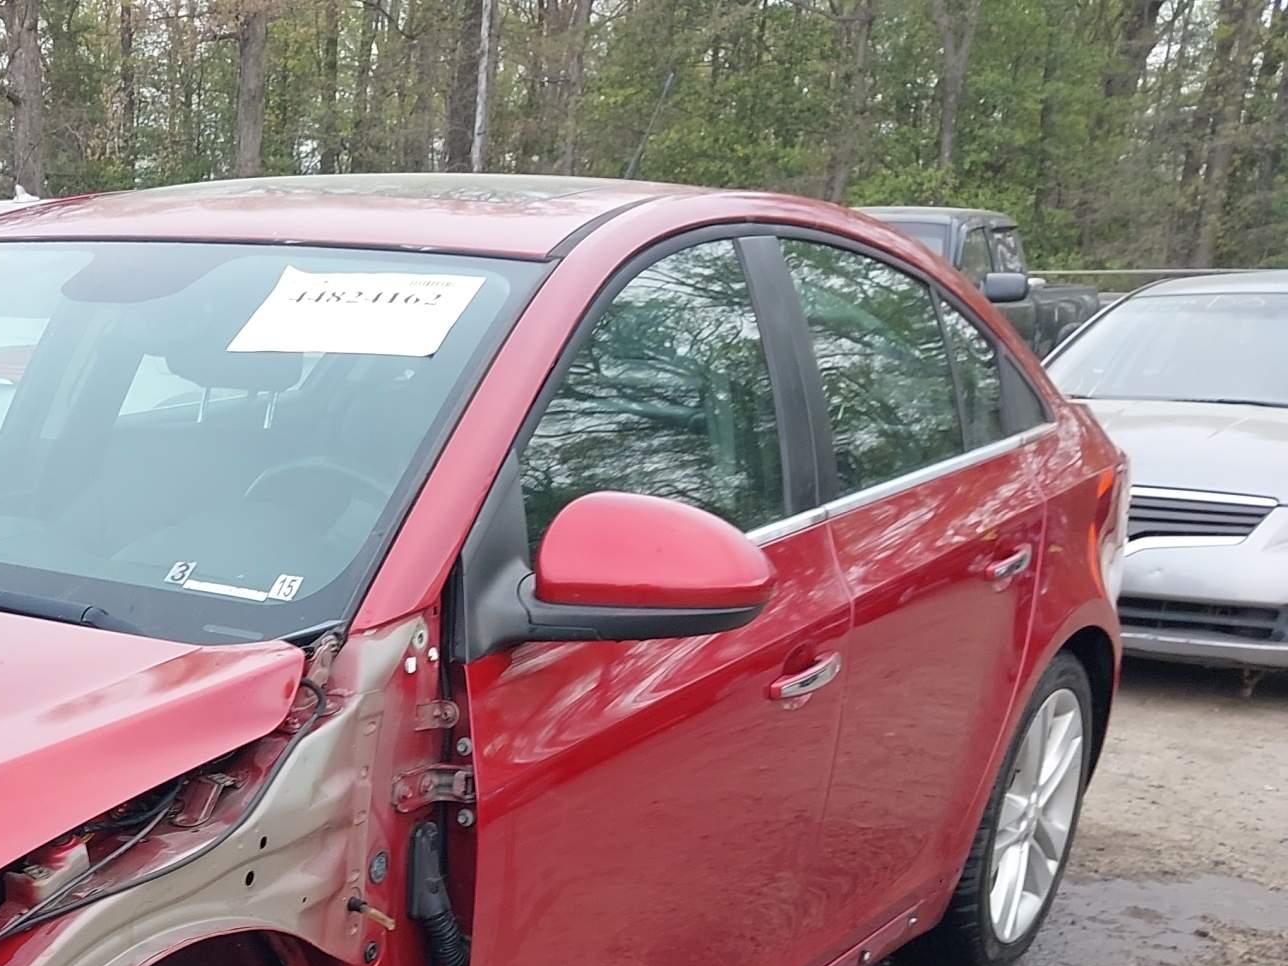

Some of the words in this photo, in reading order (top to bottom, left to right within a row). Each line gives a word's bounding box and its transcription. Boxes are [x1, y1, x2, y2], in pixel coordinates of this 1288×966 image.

[288, 290, 443, 307] 44824162
[170, 562, 190, 582] 3
[276, 577, 298, 598] 15
